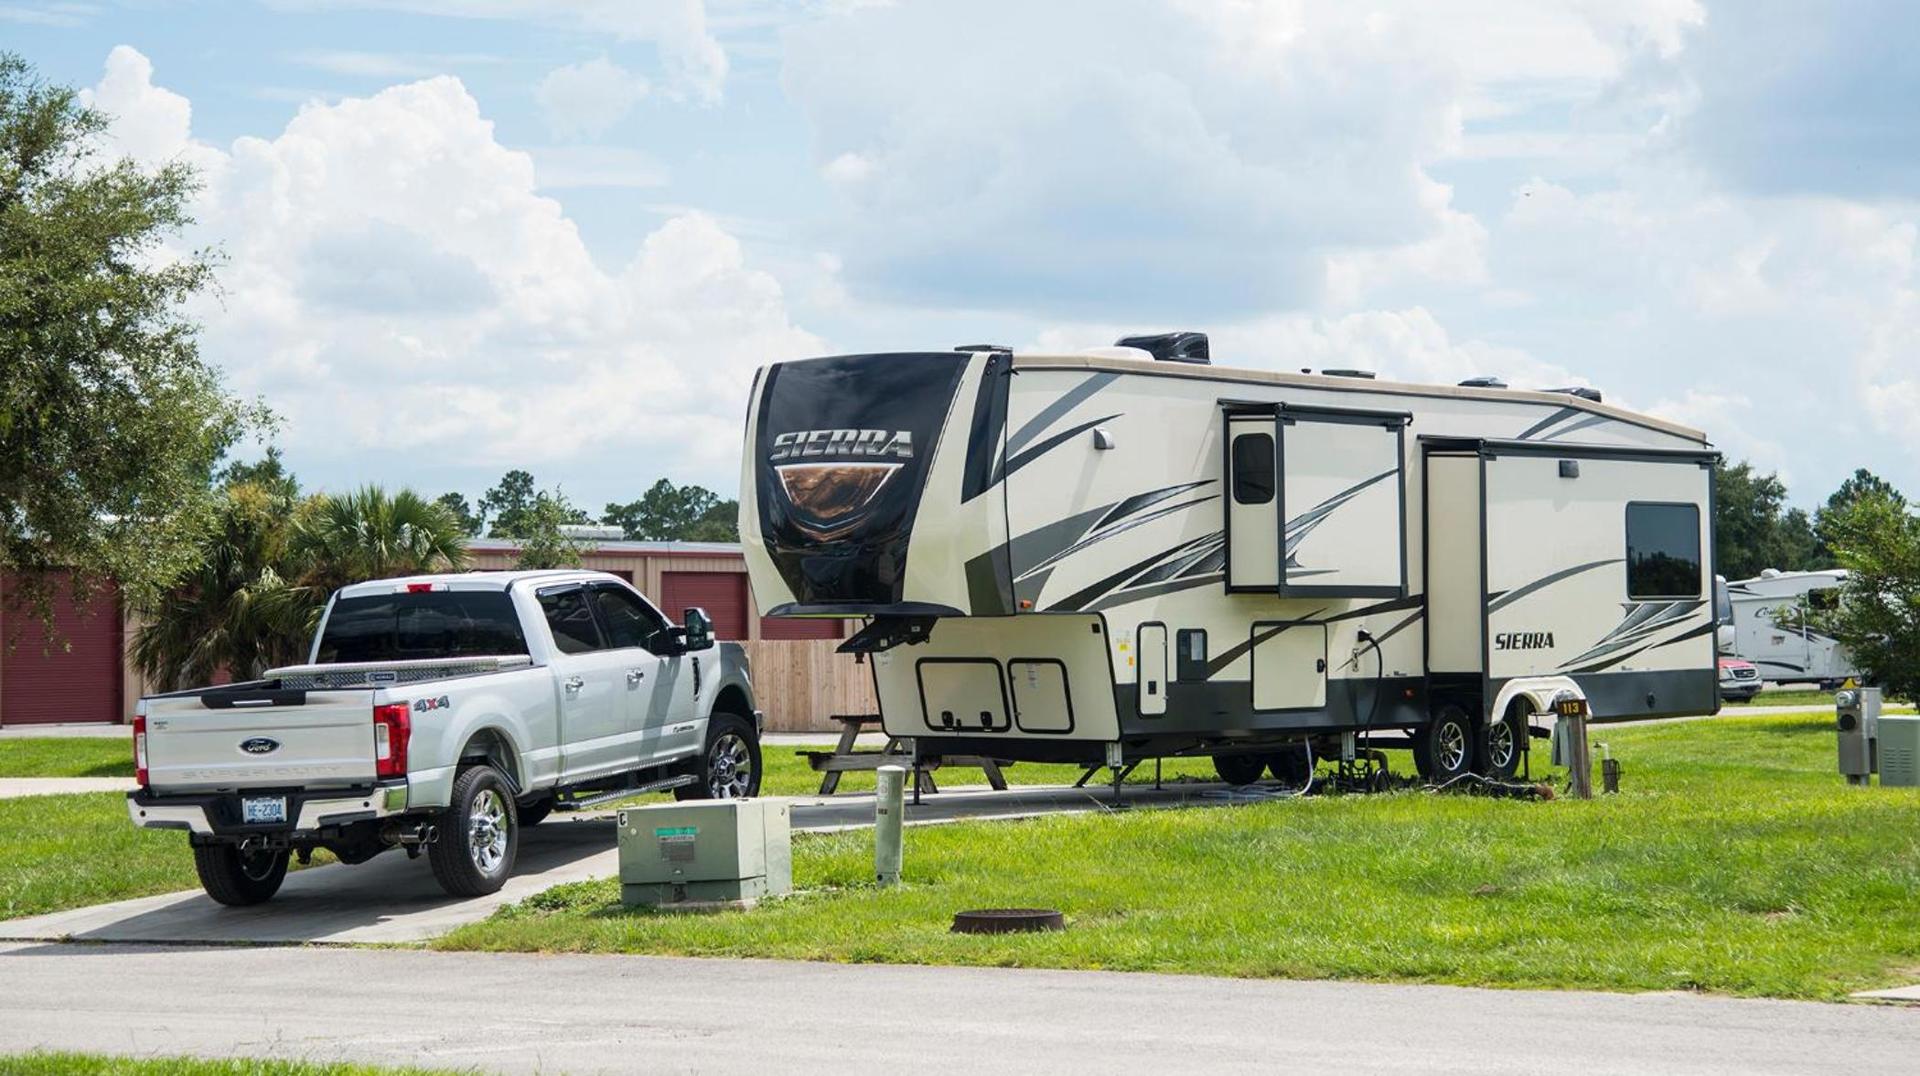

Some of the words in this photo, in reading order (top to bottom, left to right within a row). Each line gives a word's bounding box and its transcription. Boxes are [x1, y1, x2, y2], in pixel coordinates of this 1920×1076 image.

[770, 429, 914, 460] SIERRA
[1495, 631, 1555, 650] SIERRA
[1562, 701, 1580, 715] 113
